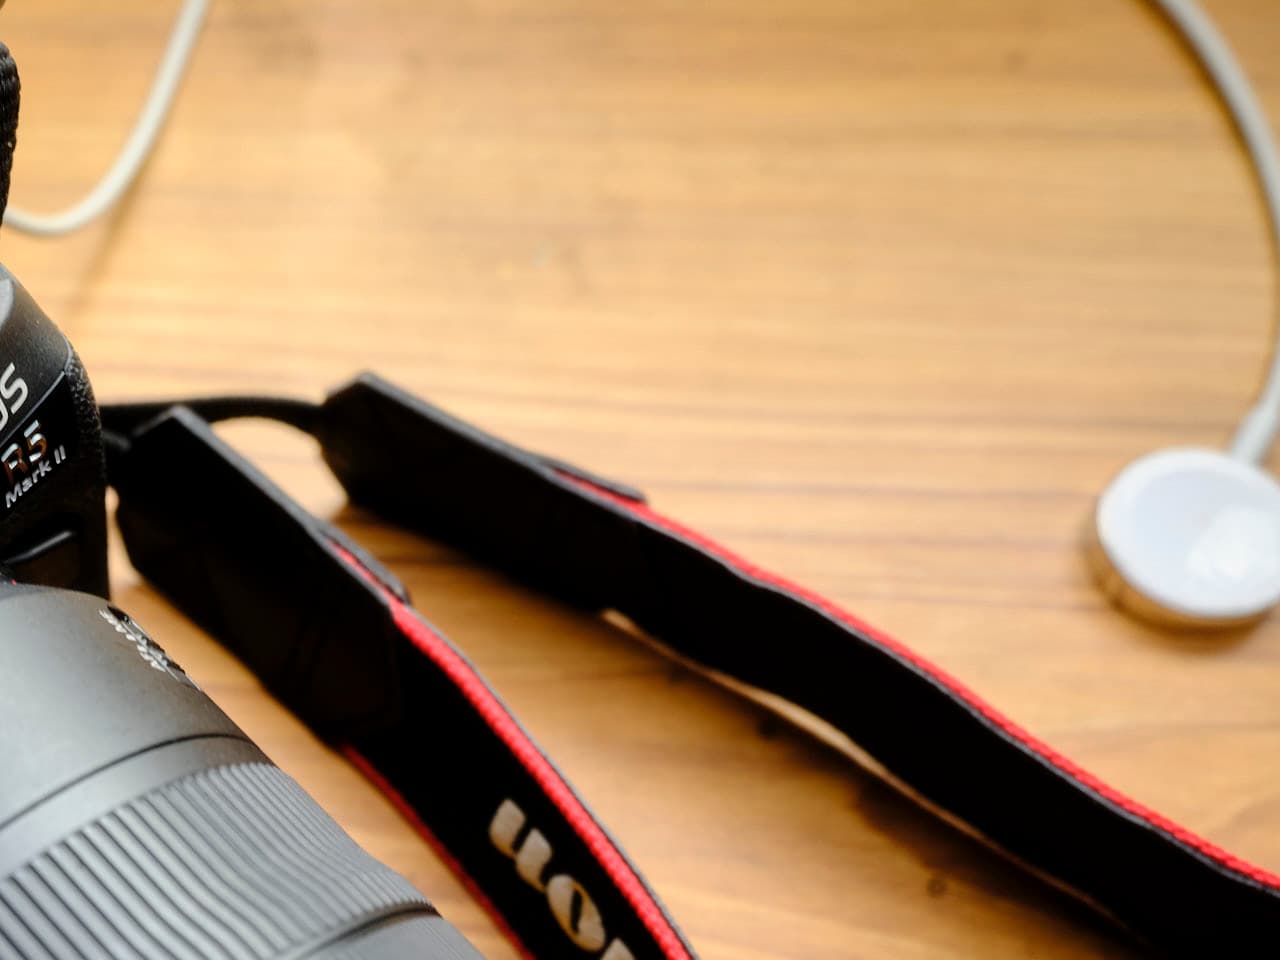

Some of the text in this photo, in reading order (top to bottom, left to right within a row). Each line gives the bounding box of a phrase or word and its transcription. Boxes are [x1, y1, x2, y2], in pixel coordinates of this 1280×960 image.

[1, 420, 47, 484] R5
[6, 444, 66, 508] Mark II
